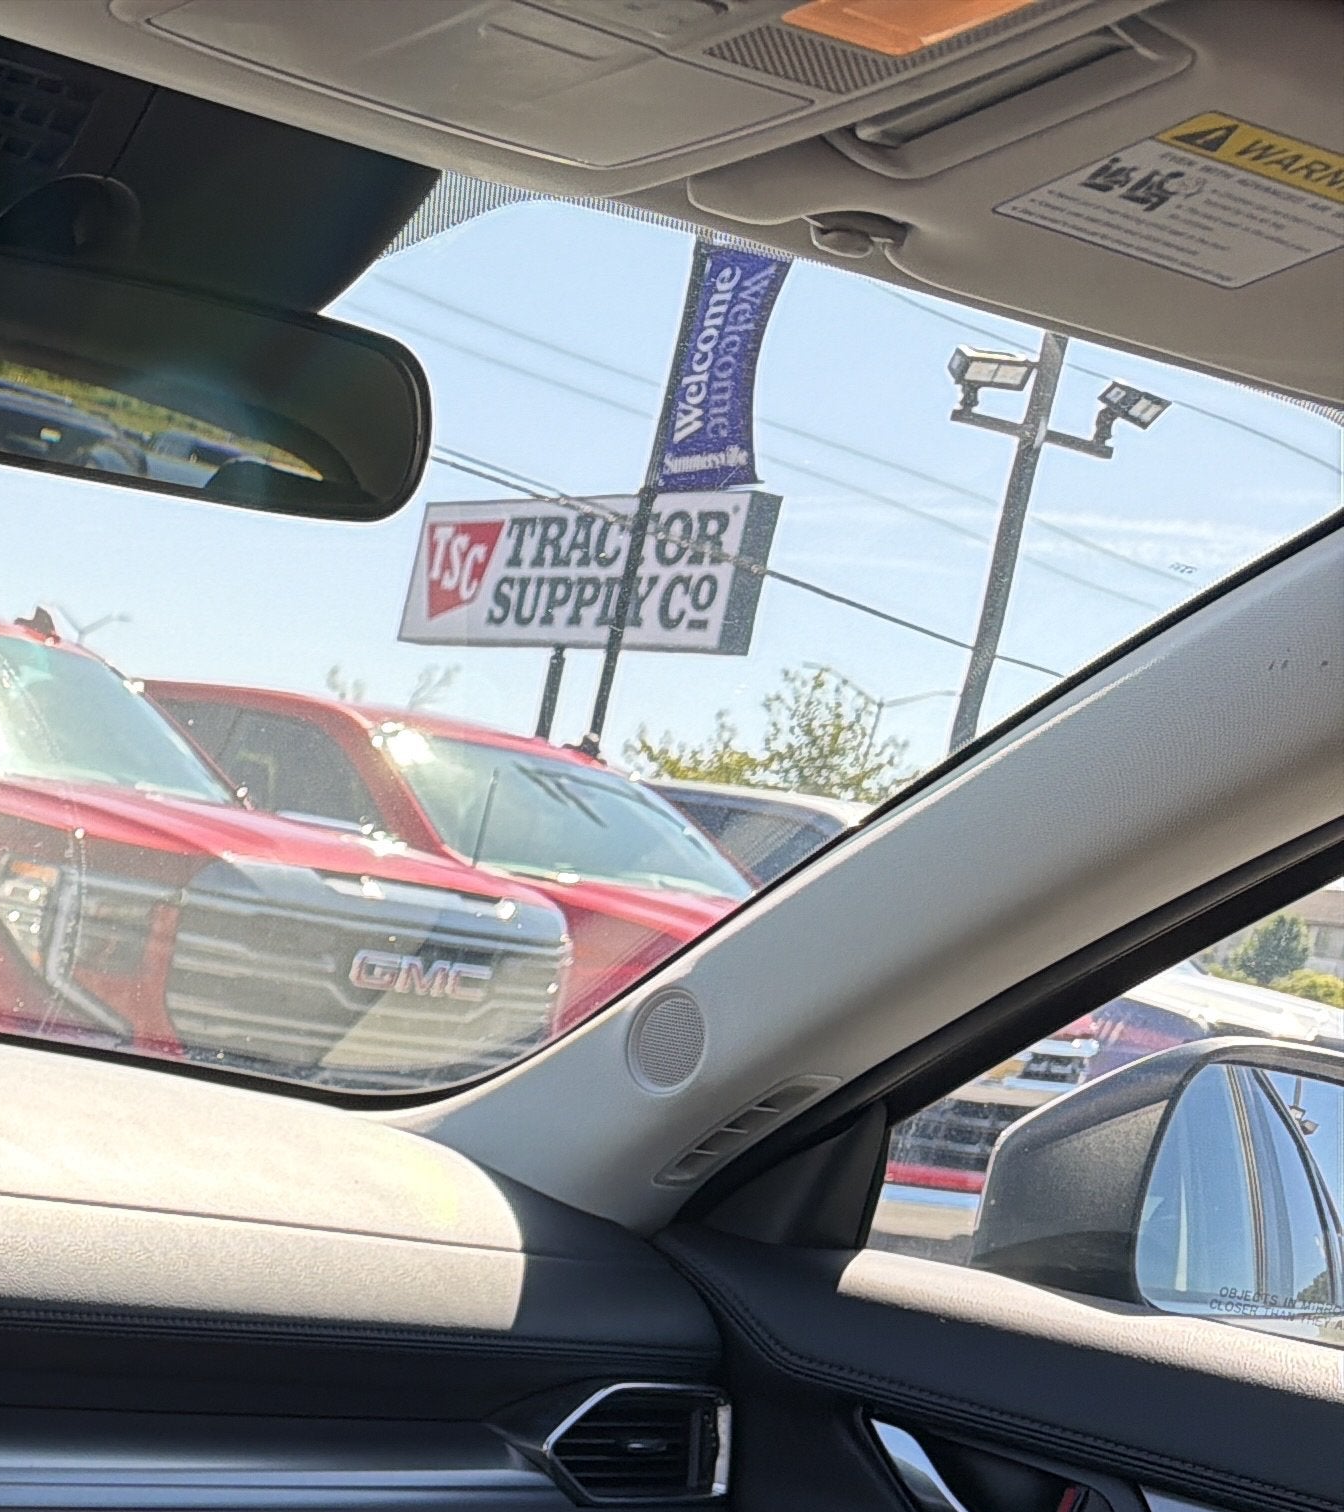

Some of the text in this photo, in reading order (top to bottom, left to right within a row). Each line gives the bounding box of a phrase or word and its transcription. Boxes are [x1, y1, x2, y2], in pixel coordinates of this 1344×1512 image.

[672, 266, 742, 444] Welcome
[707, 264, 777, 438] Welcome
[429, 526, 488, 600] TSC
[348, 948, 494, 1000] GMC
[1209, 1299, 1259, 1315] CLOSER
[1264, 1307, 1296, 1322] THAN
[1301, 1315, 1331, 1328] THEY
[1219, 1286, 1278, 1306] OBJECTS
[1283, 1297, 1297, 1309] IN
